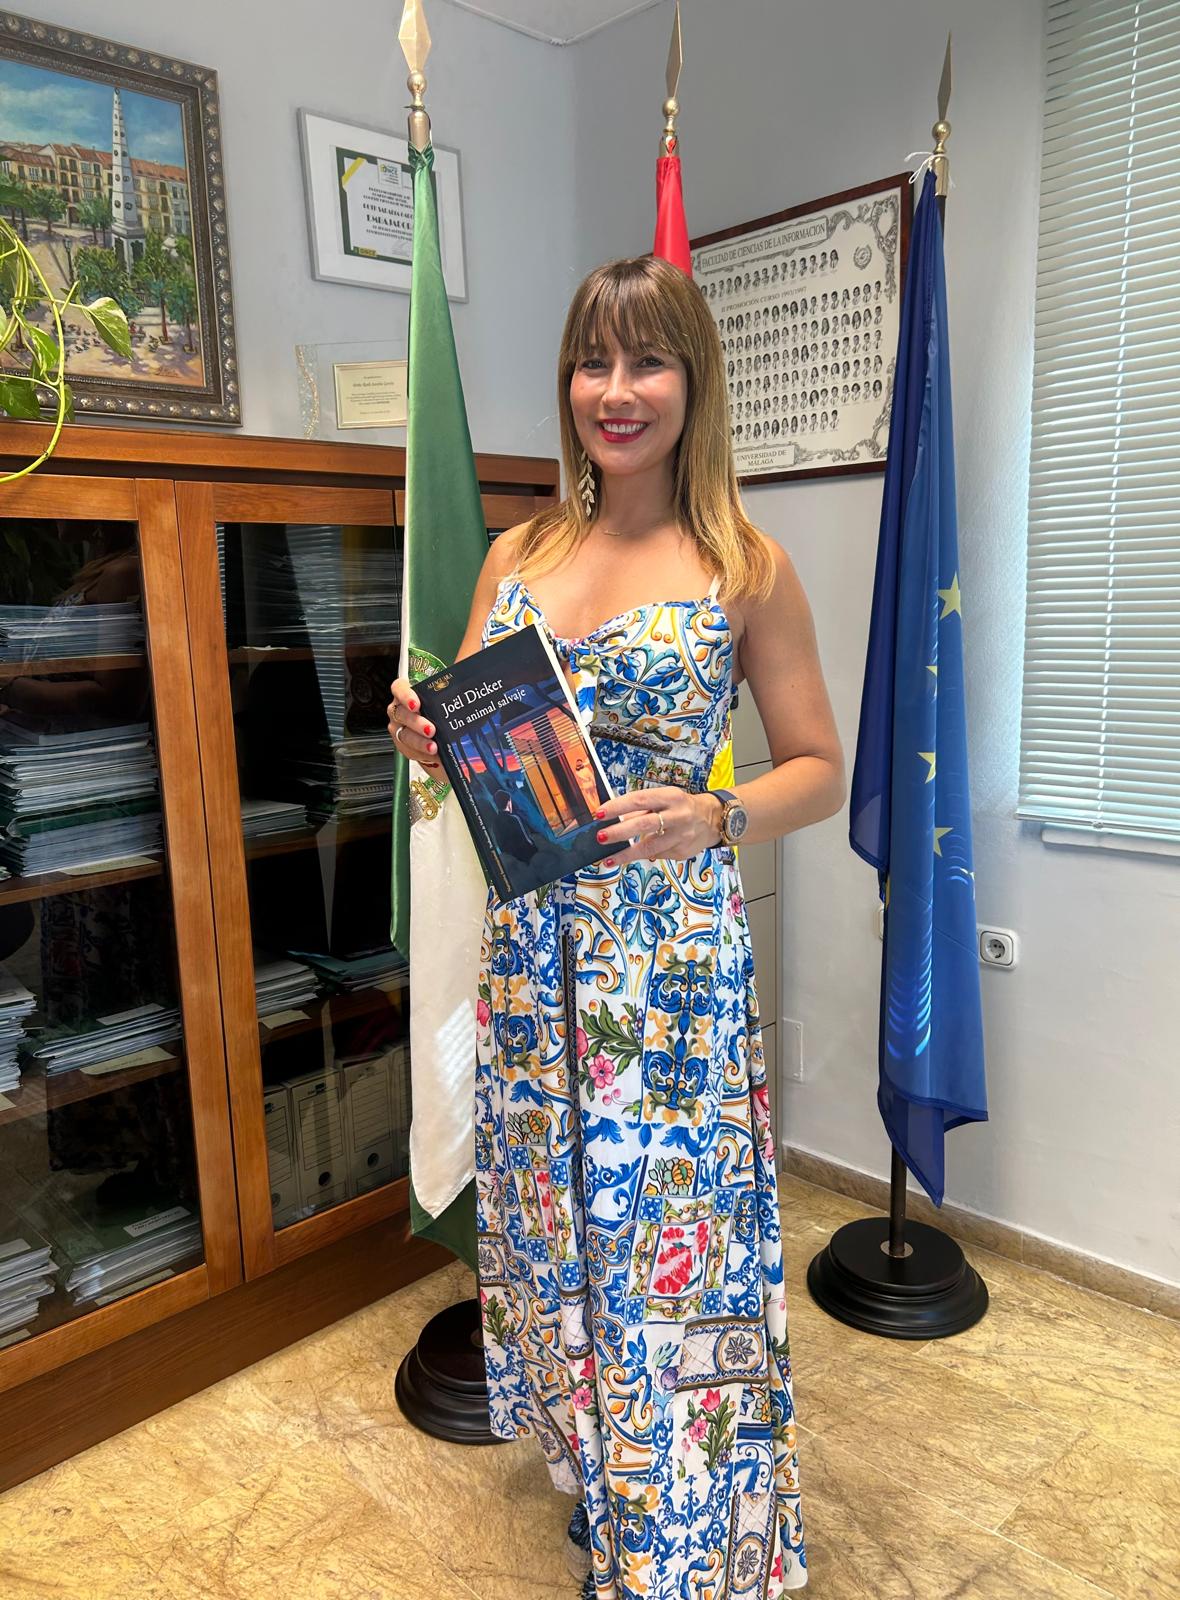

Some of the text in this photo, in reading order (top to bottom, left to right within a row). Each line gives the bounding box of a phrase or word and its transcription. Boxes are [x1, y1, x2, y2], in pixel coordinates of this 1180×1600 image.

[702, 252, 728, 268] FACULTAD
[728, 249, 738, 260] DE
[738, 241, 763, 258] CIENCIAS
[764, 238, 774, 250] DE
[774, 234, 782, 246] LA
[760, 293, 781, 305] CURSO
[736, 451, 777, 462] UNIVERSIDAD
[441, 680, 503, 718] Joël Dicker
[449, 688, 526, 730] Un animal salvaje
